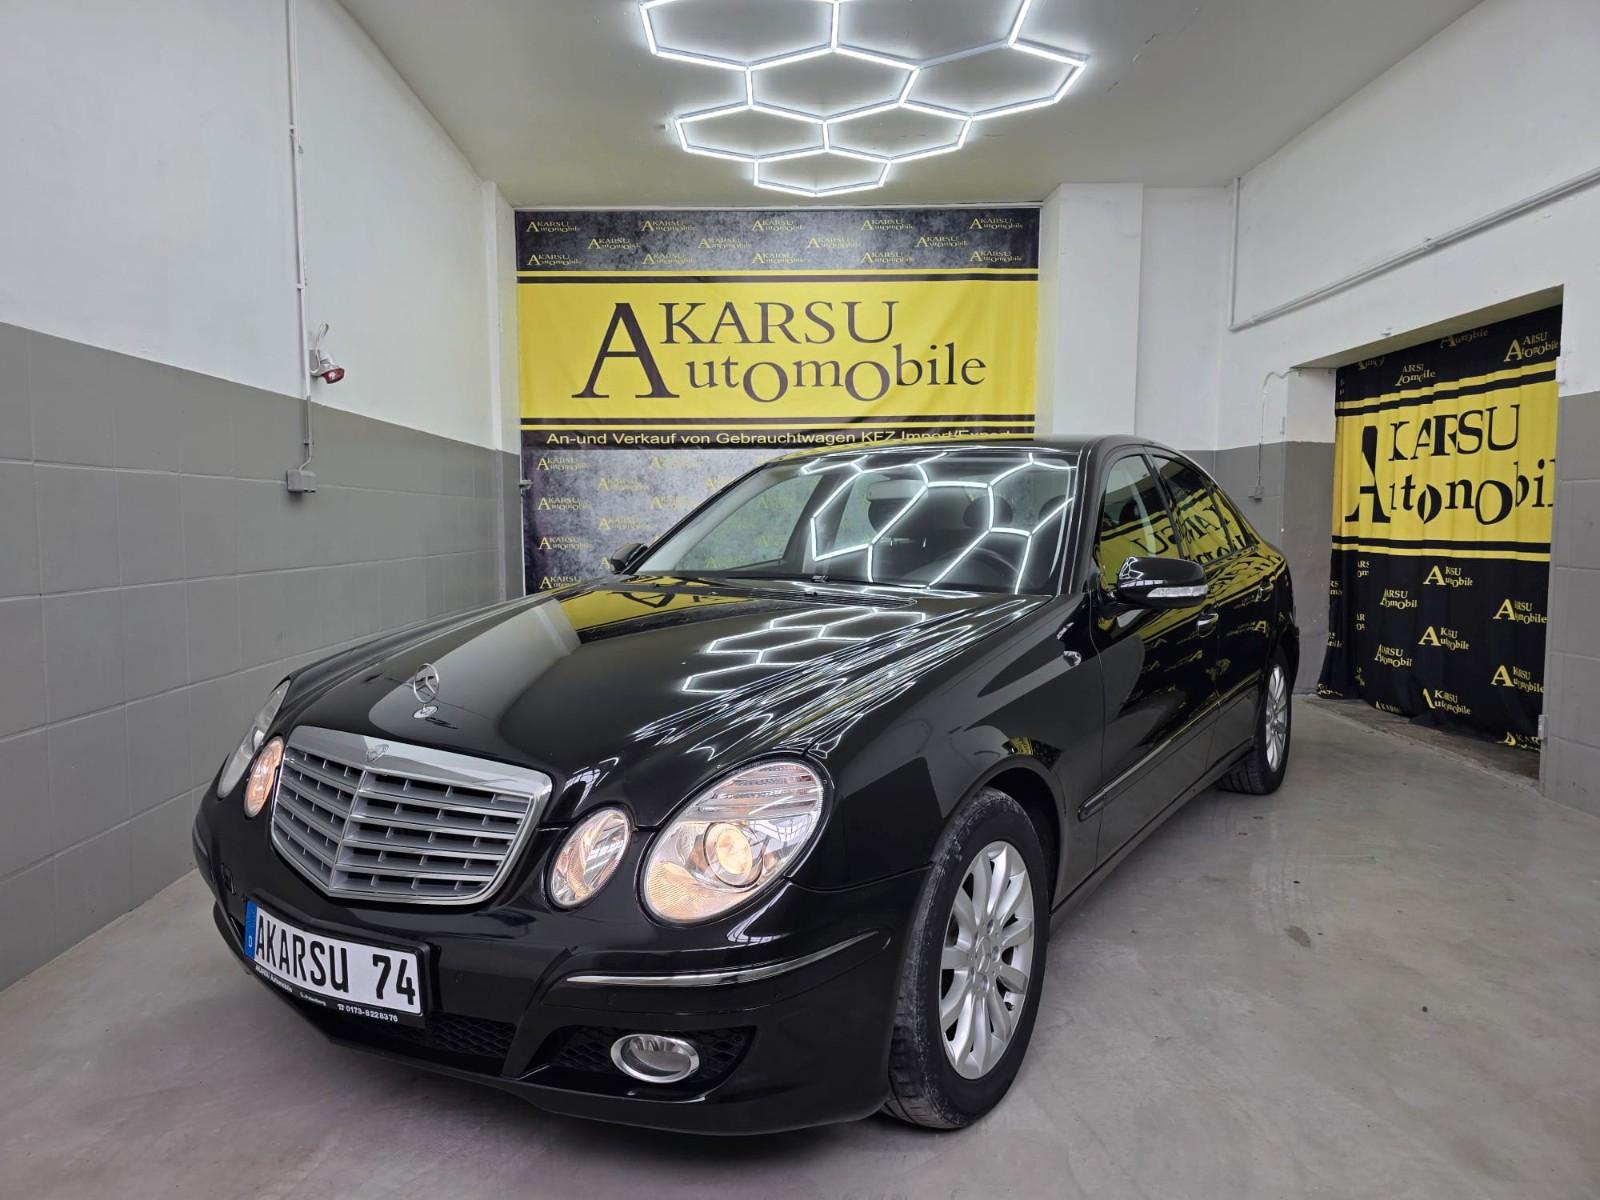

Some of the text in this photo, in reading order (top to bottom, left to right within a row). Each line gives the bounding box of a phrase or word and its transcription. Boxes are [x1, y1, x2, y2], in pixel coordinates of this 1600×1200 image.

[571, 301, 899, 398] AKARSU
[546, 432, 607, 445] An-und
[612, 432, 676, 445] Verkauf
[680, 434, 710, 445] von
[715, 431, 856, 446] Gebrauchtwagen
[861, 431, 896, 443] KFZ
[255, 914, 416, 1006] AKARSU 74
